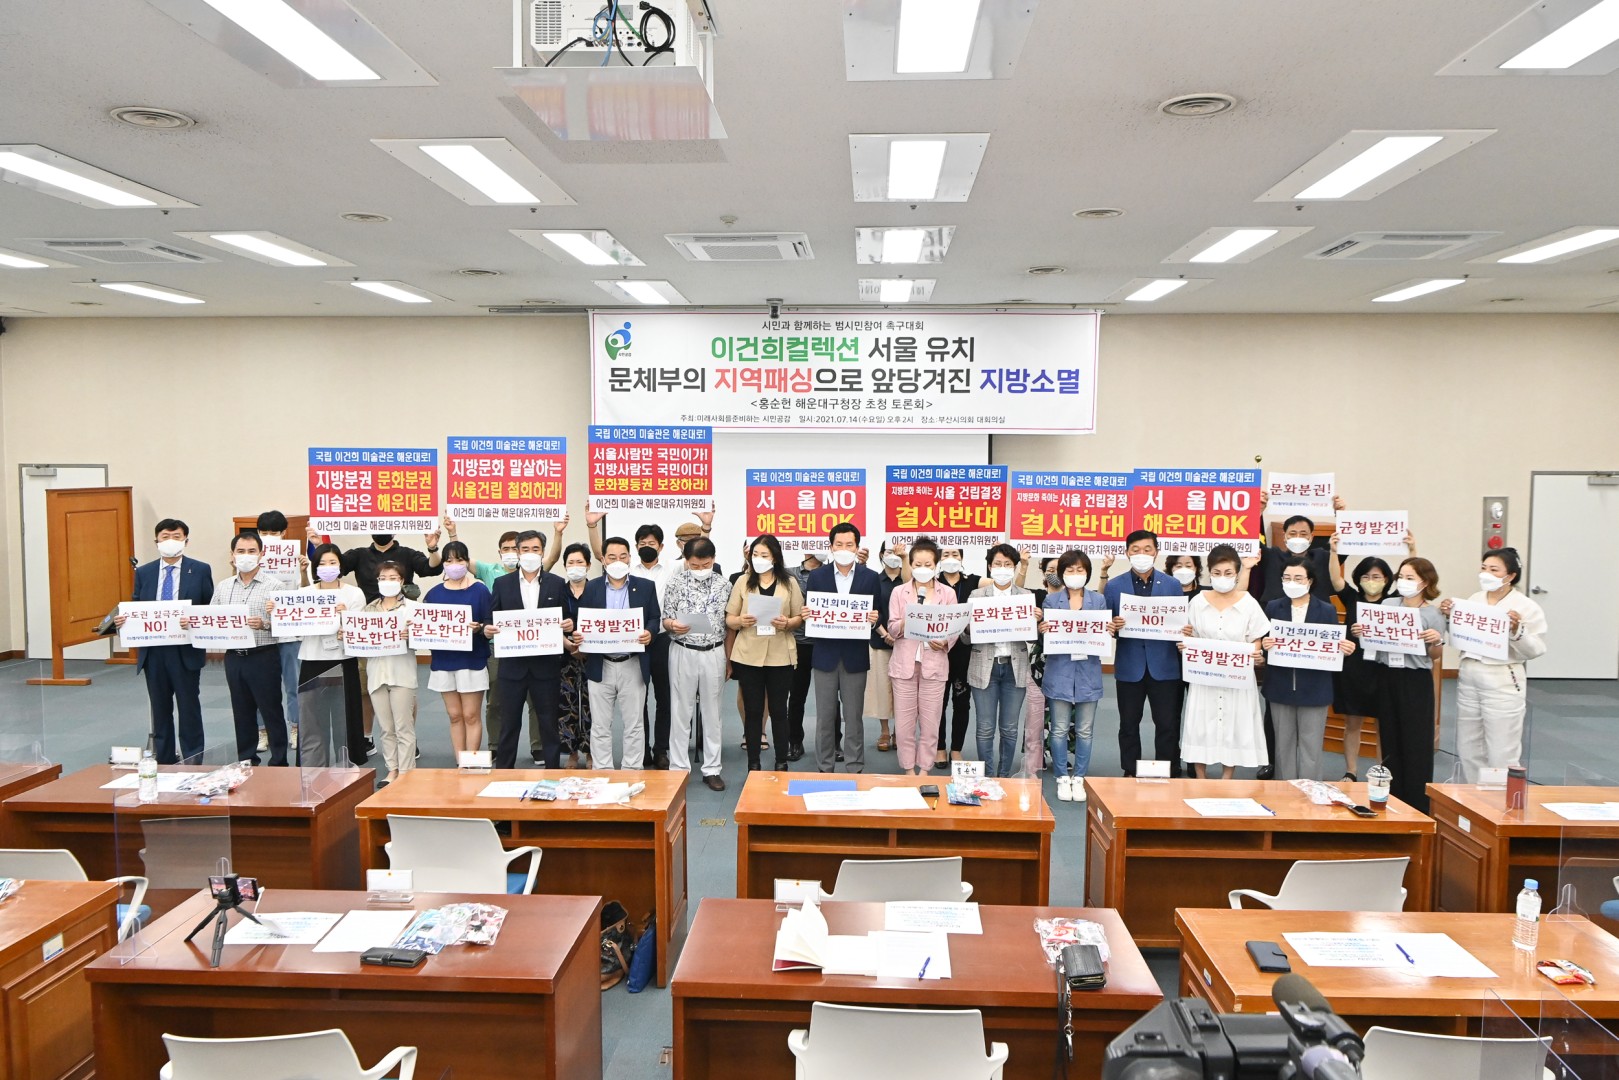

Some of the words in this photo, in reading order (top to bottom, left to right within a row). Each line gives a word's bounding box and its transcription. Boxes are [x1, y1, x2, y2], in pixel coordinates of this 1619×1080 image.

[762, 320, 791, 331] 시민과
[793, 320, 831, 331] 함께하는
[835, 320, 882, 331] 범시민참여
[886, 320, 924, 331] 촉구대회
[711, 336, 859, 362] 이건희컬렉션
[868, 336, 918, 362] 서울
[925, 336, 975, 362] 유치
[608, 367, 705, 393] 문체부의
[714, 367, 863, 393] 지역패싱으로
[871, 368, 971, 394] 앞당겨진
[980, 368, 1080, 394] 지방소멸
[795, 398, 861, 410] 해운대구청장
[865, 398, 887, 410] 초청
[762, 415, 791, 423] 시민공감
[976, 415, 1006, 424] 대회의실
[595, 429, 610, 440] 국립
[614, 429, 636, 440] 이건희
[640, 429, 670, 440] 미술관은
[673, 429, 705, 440] 해운대로!
[454, 440, 468, 450] 국립
[472, 440, 493, 450] 이건희
[496, 440, 525, 450] 미술관은
[528, 440, 560, 450] 해운대로!
[316, 452, 331, 462] 국립
[335, 452, 359, 462] 이건희
[363, 452, 393, 462] 미술관은
[397, 452, 431, 462] 해운대로!
[594, 448, 653, 460] 서울사람만
[657, 448, 708, 460] 국민이가!
[452, 459, 504, 476] 지방문화
[510, 459, 562, 476] 말살하는
[594, 463, 652, 476] 지방사람도
[658, 463, 708, 476] 국민이다!
[893, 469, 908, 479] 국립
[911, 469, 932, 479] 이건희
[936, 469, 965, 479] 미술관은
[969, 469, 1001, 479] 해운대로!
[316, 471, 372, 490] 지방분권
[378, 471, 431, 490] 문화분권
[753, 472, 767, 482] 국립
[770, 472, 792, 482] 이건희
[795, 472, 824, 482] 미술관은
[828, 472, 860, 482] 해운대로!
[1018, 475, 1033, 485] 국립
[1036, 475, 1058, 486] 이건희
[1062, 475, 1091, 486] 미술관은
[1094, 476, 1126, 486] 해운대로!
[1140, 472, 1156, 482] 국립
[1159, 472, 1182, 482] 이건희
[1185, 472, 1216, 483] 미술관은
[1220, 472, 1254, 483] 해운대로!
[452, 481, 502, 499] 서울건립
[508, 481, 562, 499] 철회하라!
[594, 478, 652, 491] 문화평등권
[657, 478, 708, 491] 보장하라!
[1270, 483, 1331, 497] 문화분권!
[822, 490, 856, 509] NO
[892, 486, 914, 495] 지방문화
[916, 486, 933, 495] 죽이는
[934, 486, 955, 500] 서울
[959, 486, 1001, 500] 건립결정
[317, 494, 372, 512] 미술관은
[378, 494, 431, 512] 해운대로
[596, 499, 618, 509] 이건희
[621, 499, 644, 509] 미술관
[646, 499, 706, 509] 해운대유치위원회
[1017, 493, 1039, 502] 지방문화
[1041, 493, 1058, 502] 죽이는
[1059, 493, 1081, 508] 서울
[1085, 494, 1127, 508] 건립결정
[1213, 490, 1250, 511] NO
[454, 508, 474, 518] 이건희
[478, 508, 499, 518] 미술관
[502, 508, 559, 518] 해운대유치위원회
[896, 505, 998, 528] 결사반대
[318, 521, 340, 531] 이건희
[344, 520, 367, 531] 미술관
[370, 520, 431, 530] 해운대유치위원회
[757, 514, 816, 533] 해운대
[1021, 513, 1124, 537] 결사반대
[1143, 514, 1206, 535] 해운대
[1212, 514, 1248, 535] OK
[1340, 521, 1404, 534] 균형발전!
[1042, 544, 1063, 554] 미술관
[1165, 542, 1187, 552] 미술관
[275, 595, 336, 605] 이건희미술관
[811, 598, 869, 610] 이건희미술관
[275, 607, 336, 620] 부산으로!
[972, 606, 1033, 623] 문화분권!
[1122, 603, 1146, 613] 수도권
[188, 616, 247, 629] 문화분권!
[414, 609, 466, 623] 지방패싱
[810, 610, 869, 623] 부산으로!
[1142, 616, 1164, 625] NO!
[1362, 608, 1413, 626] 지방패싱
[1453, 610, 1506, 635] 문화분권!
[144, 621, 167, 632] NO!
[346, 616, 398, 630] 지방패싱
[580, 619, 640, 633] 균형발전!
[927, 623, 948, 633] NO!
[412, 623, 468, 638] 분노한다!
[517, 629, 539, 641] NO!
[1274, 625, 1341, 640] 이건희미술관
[1186, 648, 1250, 668] 균형발전!
